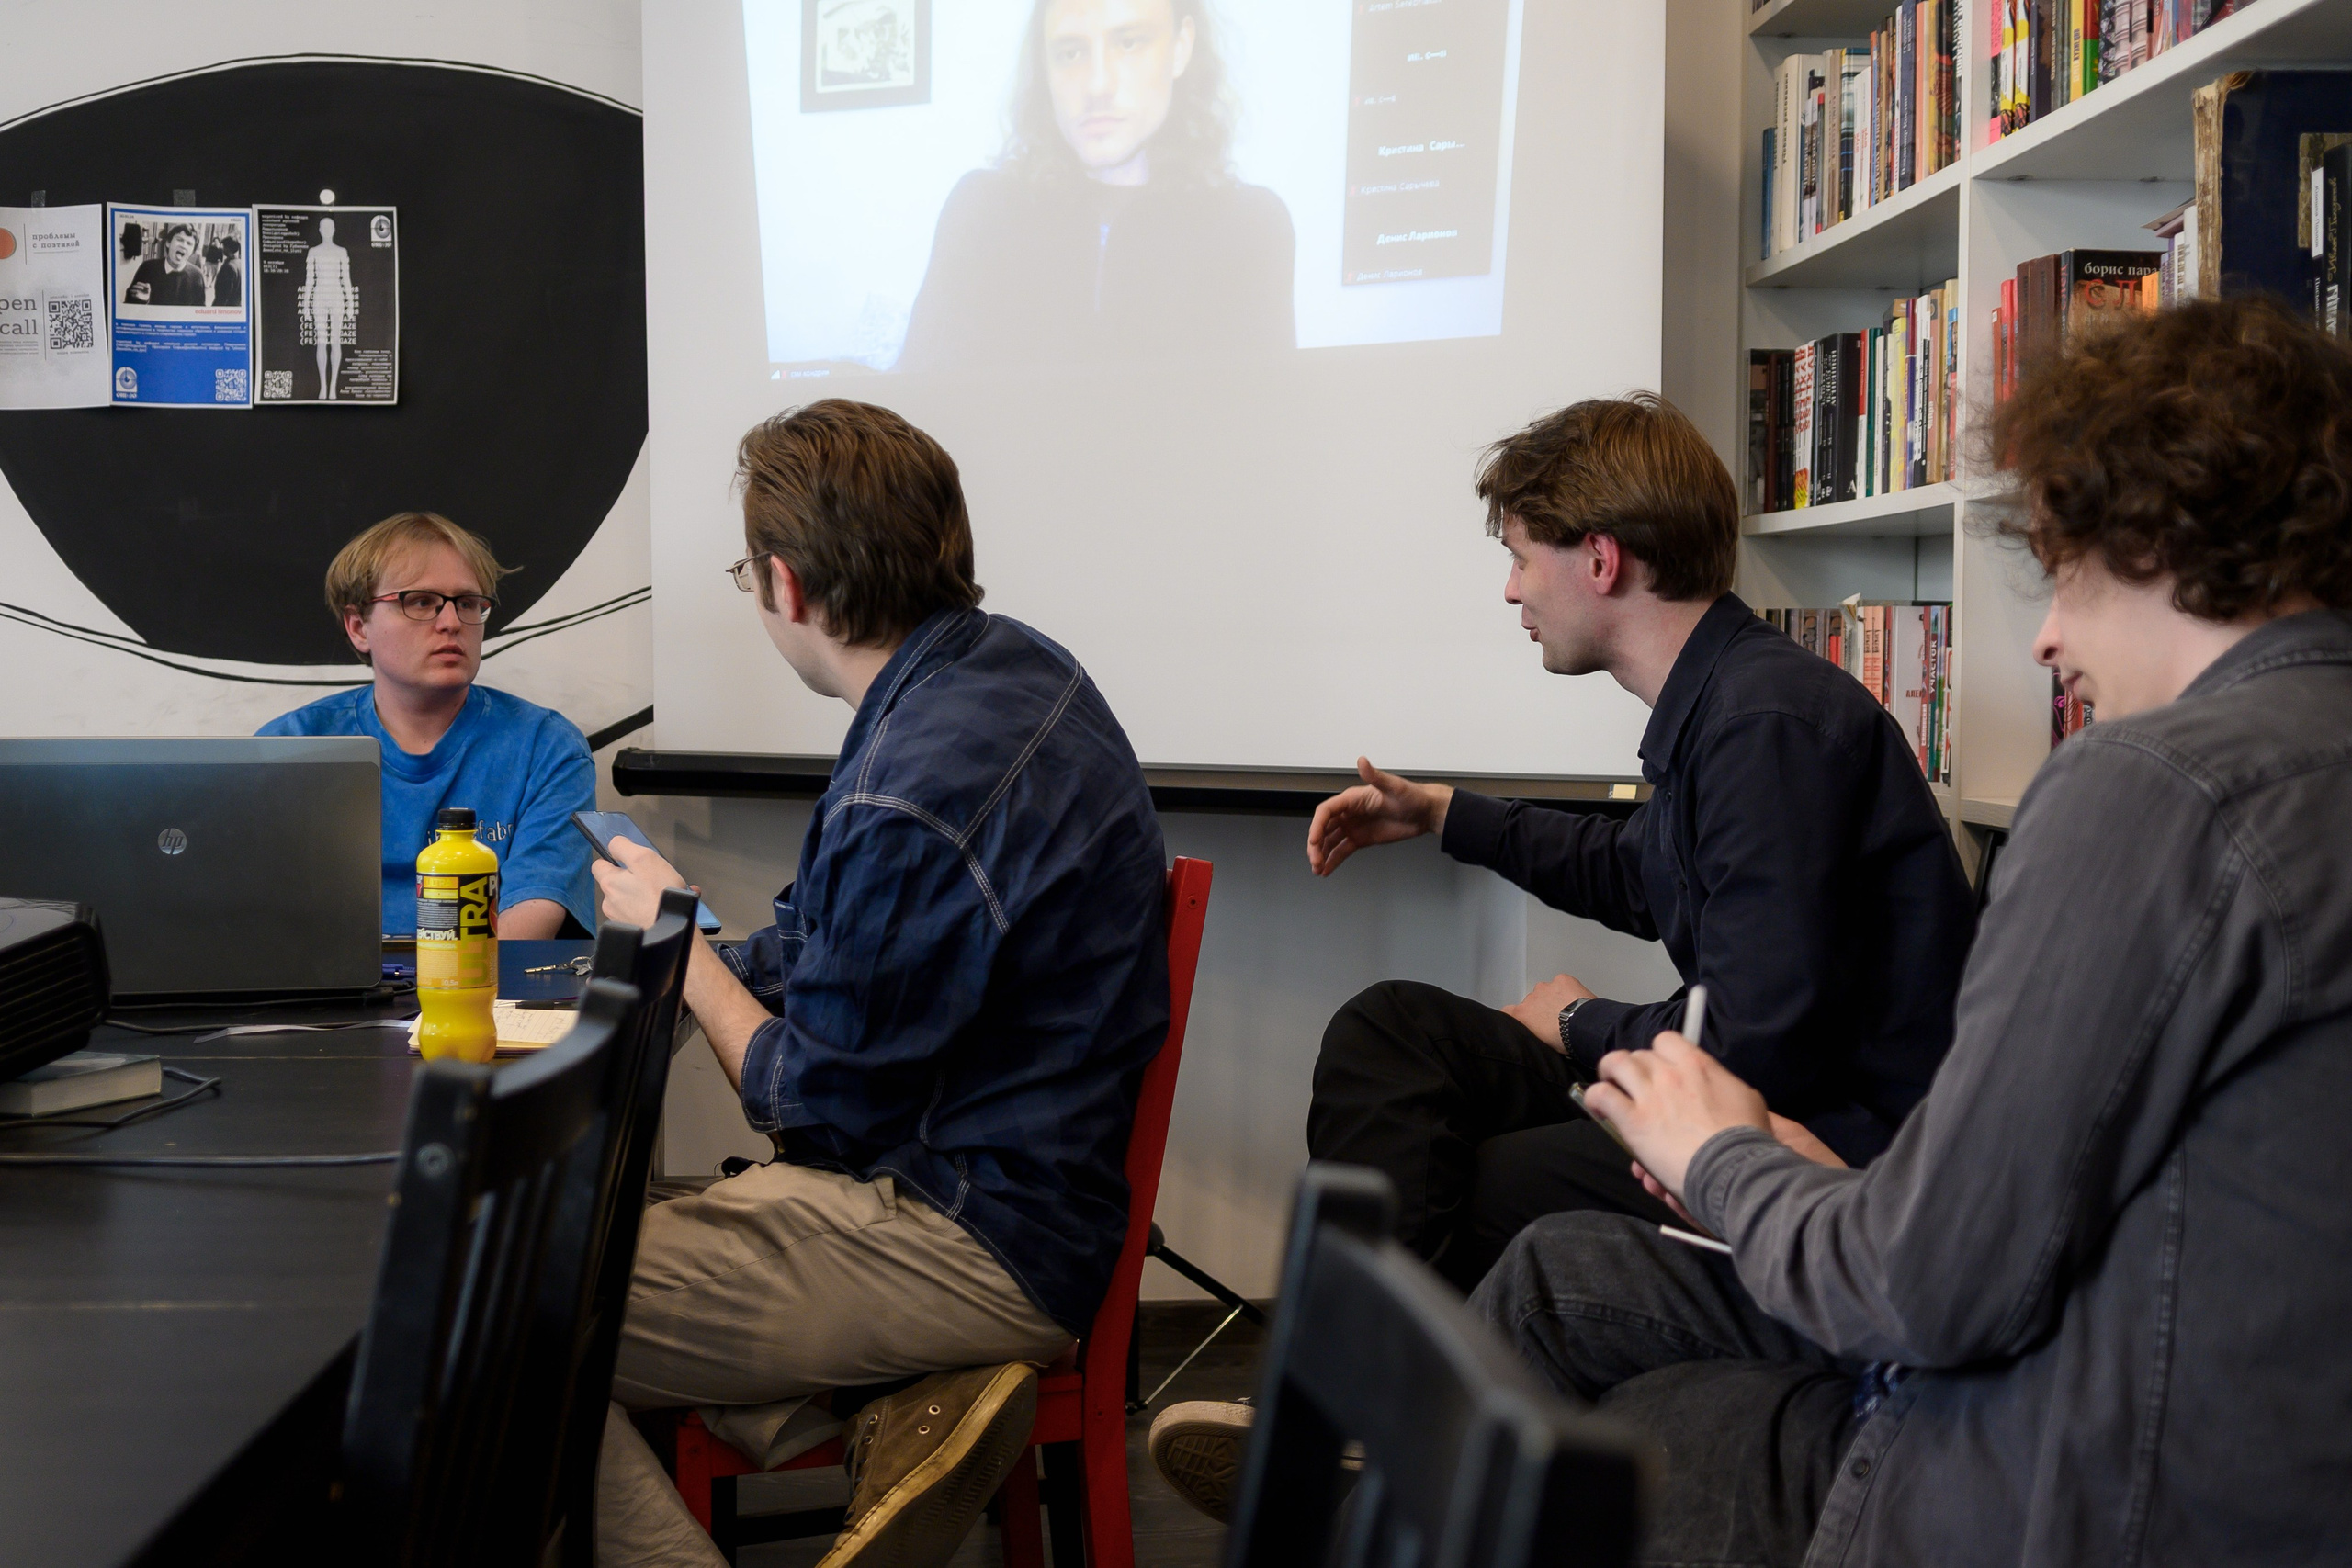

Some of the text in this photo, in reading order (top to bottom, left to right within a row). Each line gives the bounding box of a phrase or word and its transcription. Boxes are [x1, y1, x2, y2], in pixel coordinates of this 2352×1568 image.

[1379, 143, 1424, 156] Кристина
[1901, 129, 1909, 175] Владимир
[32, 232, 75, 242] проблемы
[41, 239, 80, 249] поэтикой
[1376, 230, 1458, 245] Денис Ларионов
[1356, 268, 1423, 282] Денис Ларионов
[2084, 262, 2159, 277] борис пара
[0, 319, 39, 335] call
[161, 828, 185, 854] hp
[460, 875, 488, 986] ULTRA
